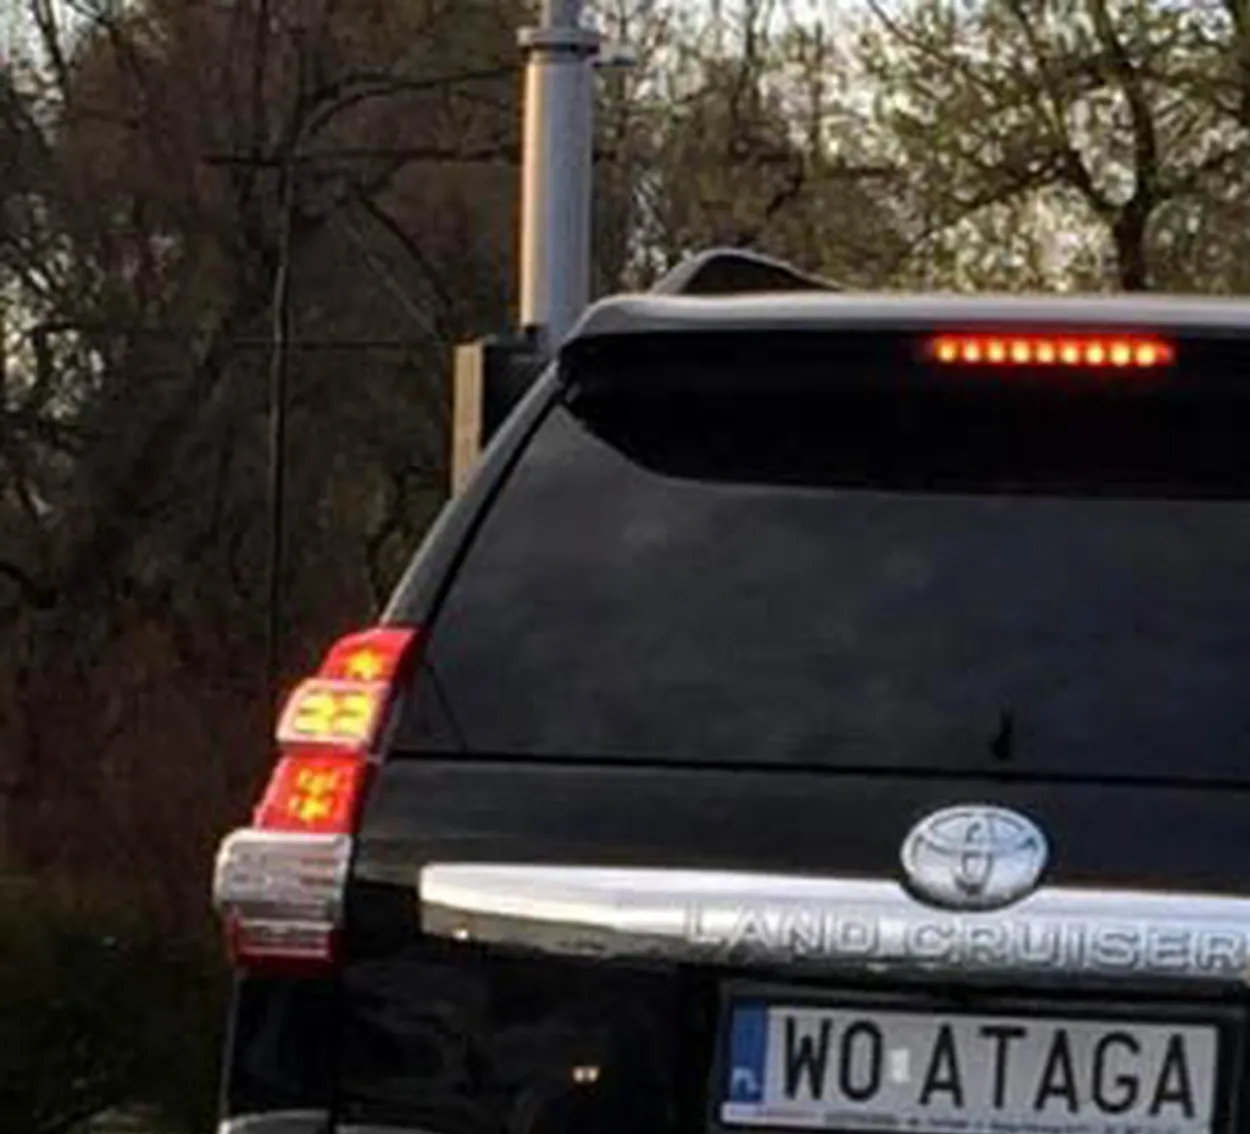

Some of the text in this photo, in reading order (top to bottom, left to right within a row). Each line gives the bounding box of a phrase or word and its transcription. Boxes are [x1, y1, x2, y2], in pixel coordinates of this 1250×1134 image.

[684, 902, 1246, 970] LAND CRUISER
[919, 1021, 1196, 1119] ATAGA
